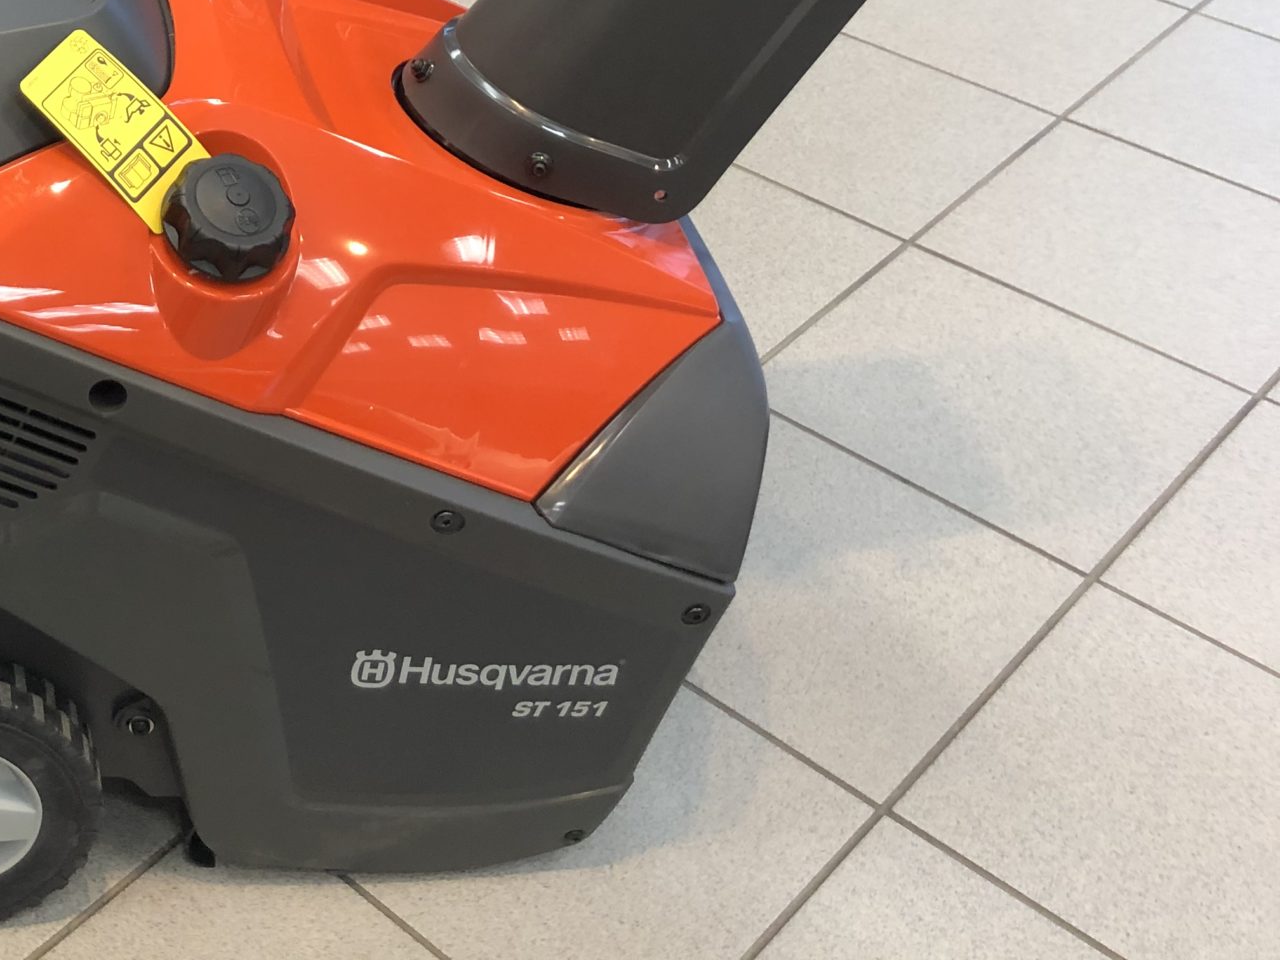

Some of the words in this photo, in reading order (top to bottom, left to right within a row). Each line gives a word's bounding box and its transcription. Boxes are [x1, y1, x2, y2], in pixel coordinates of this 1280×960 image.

[398, 656, 619, 690] Husqvarna
[511, 701, 551, 717] ST
[556, 701, 609, 717] 151
